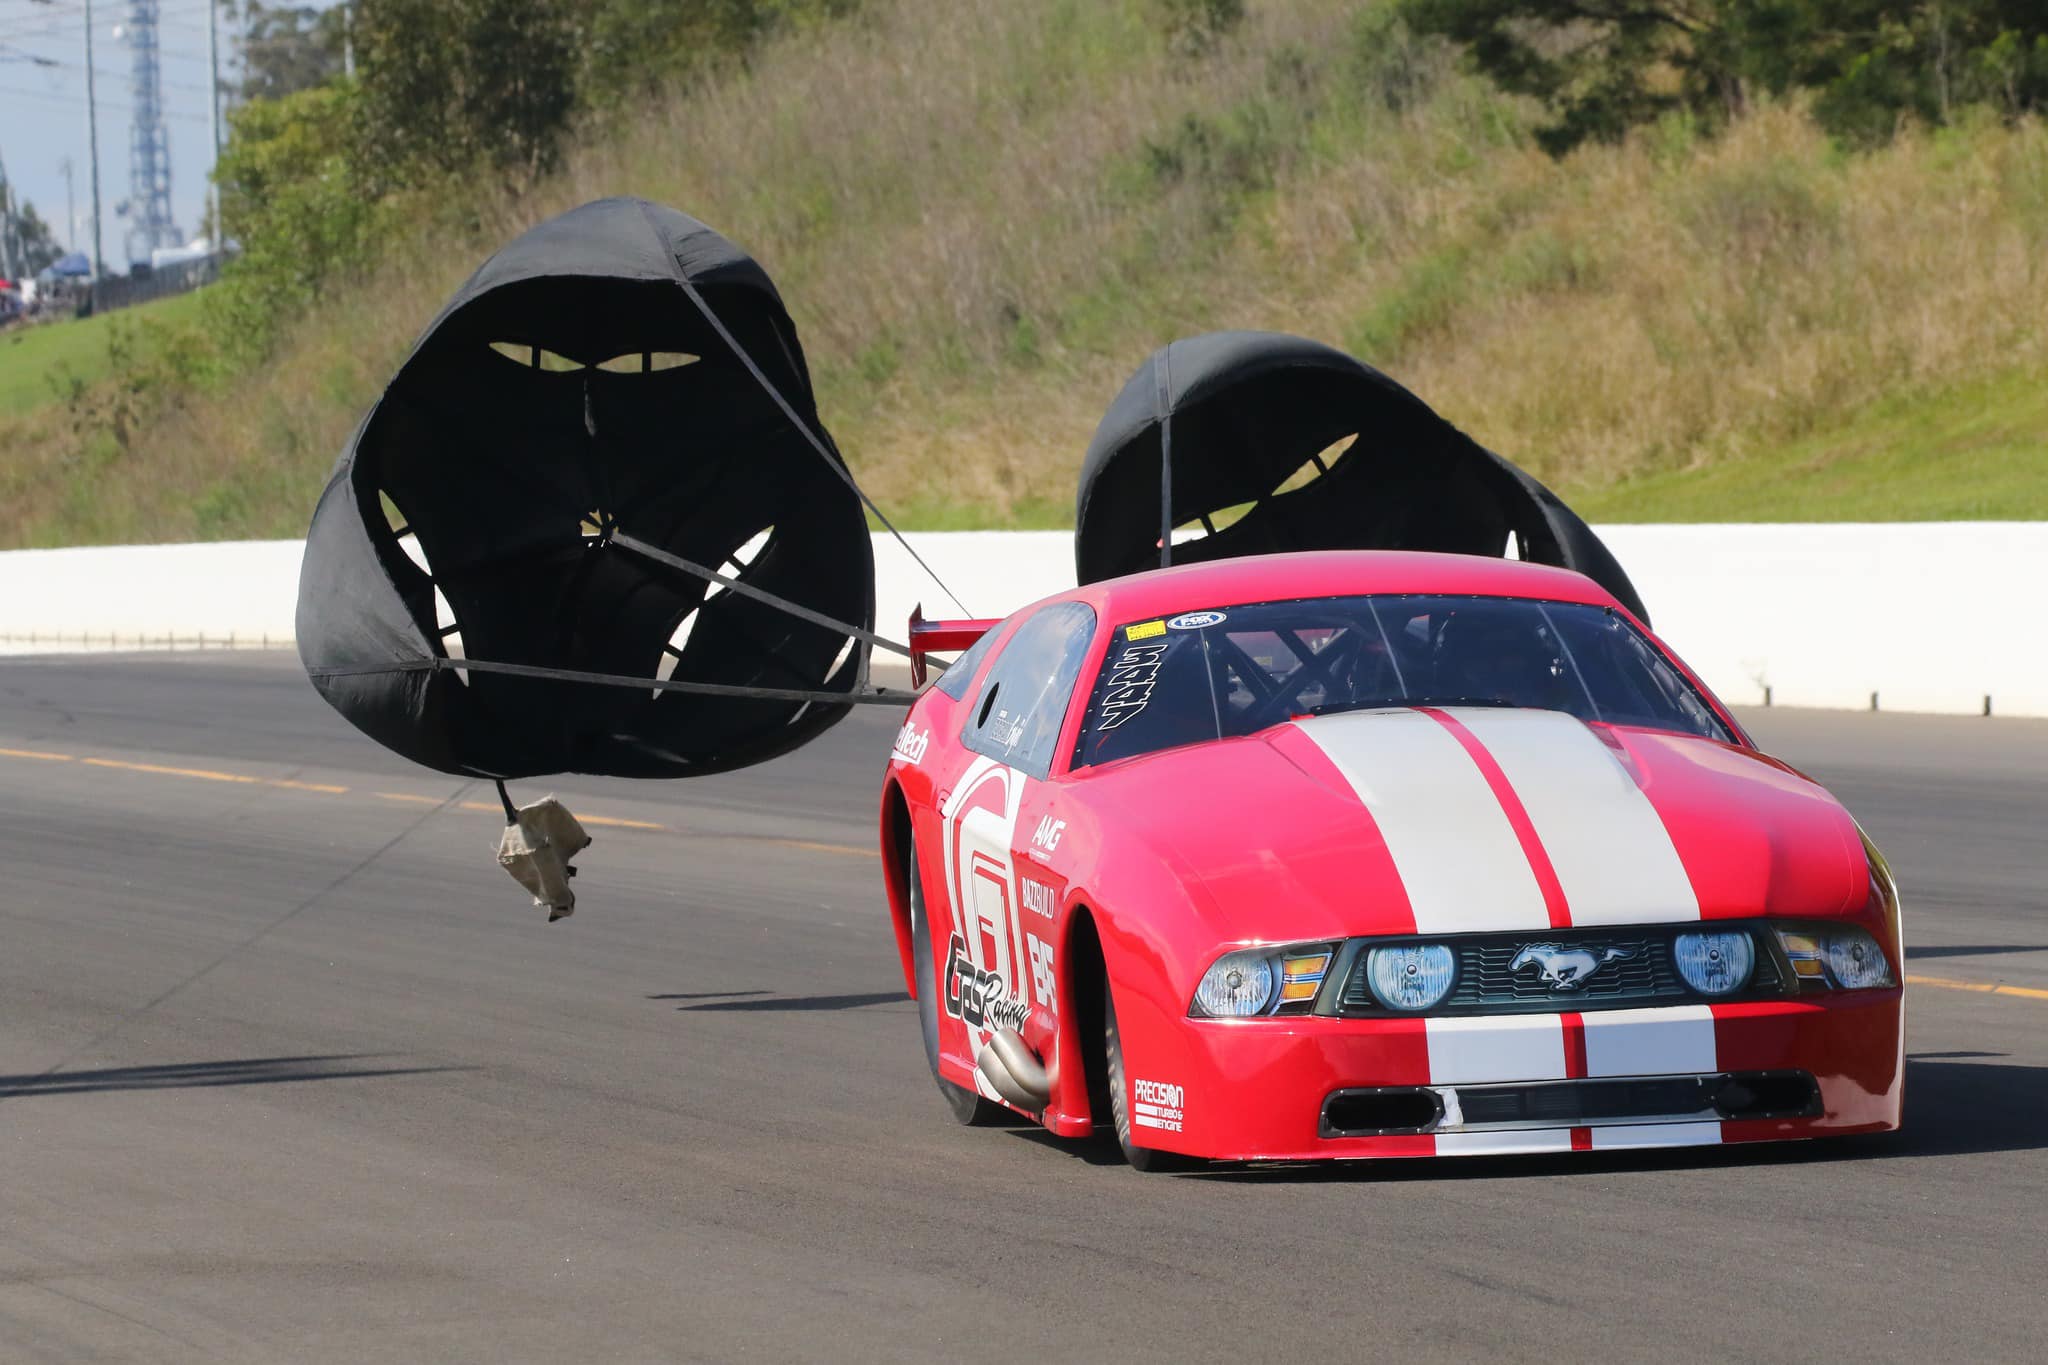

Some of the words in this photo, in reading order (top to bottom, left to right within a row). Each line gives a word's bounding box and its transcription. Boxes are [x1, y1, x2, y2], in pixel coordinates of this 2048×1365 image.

[1032, 814, 1066, 850] AMG
[1135, 1079, 1184, 1108] PRECISION
[1157, 1106, 1177, 1119] TURBO
[1157, 1118, 1183, 1132] ENGINE
